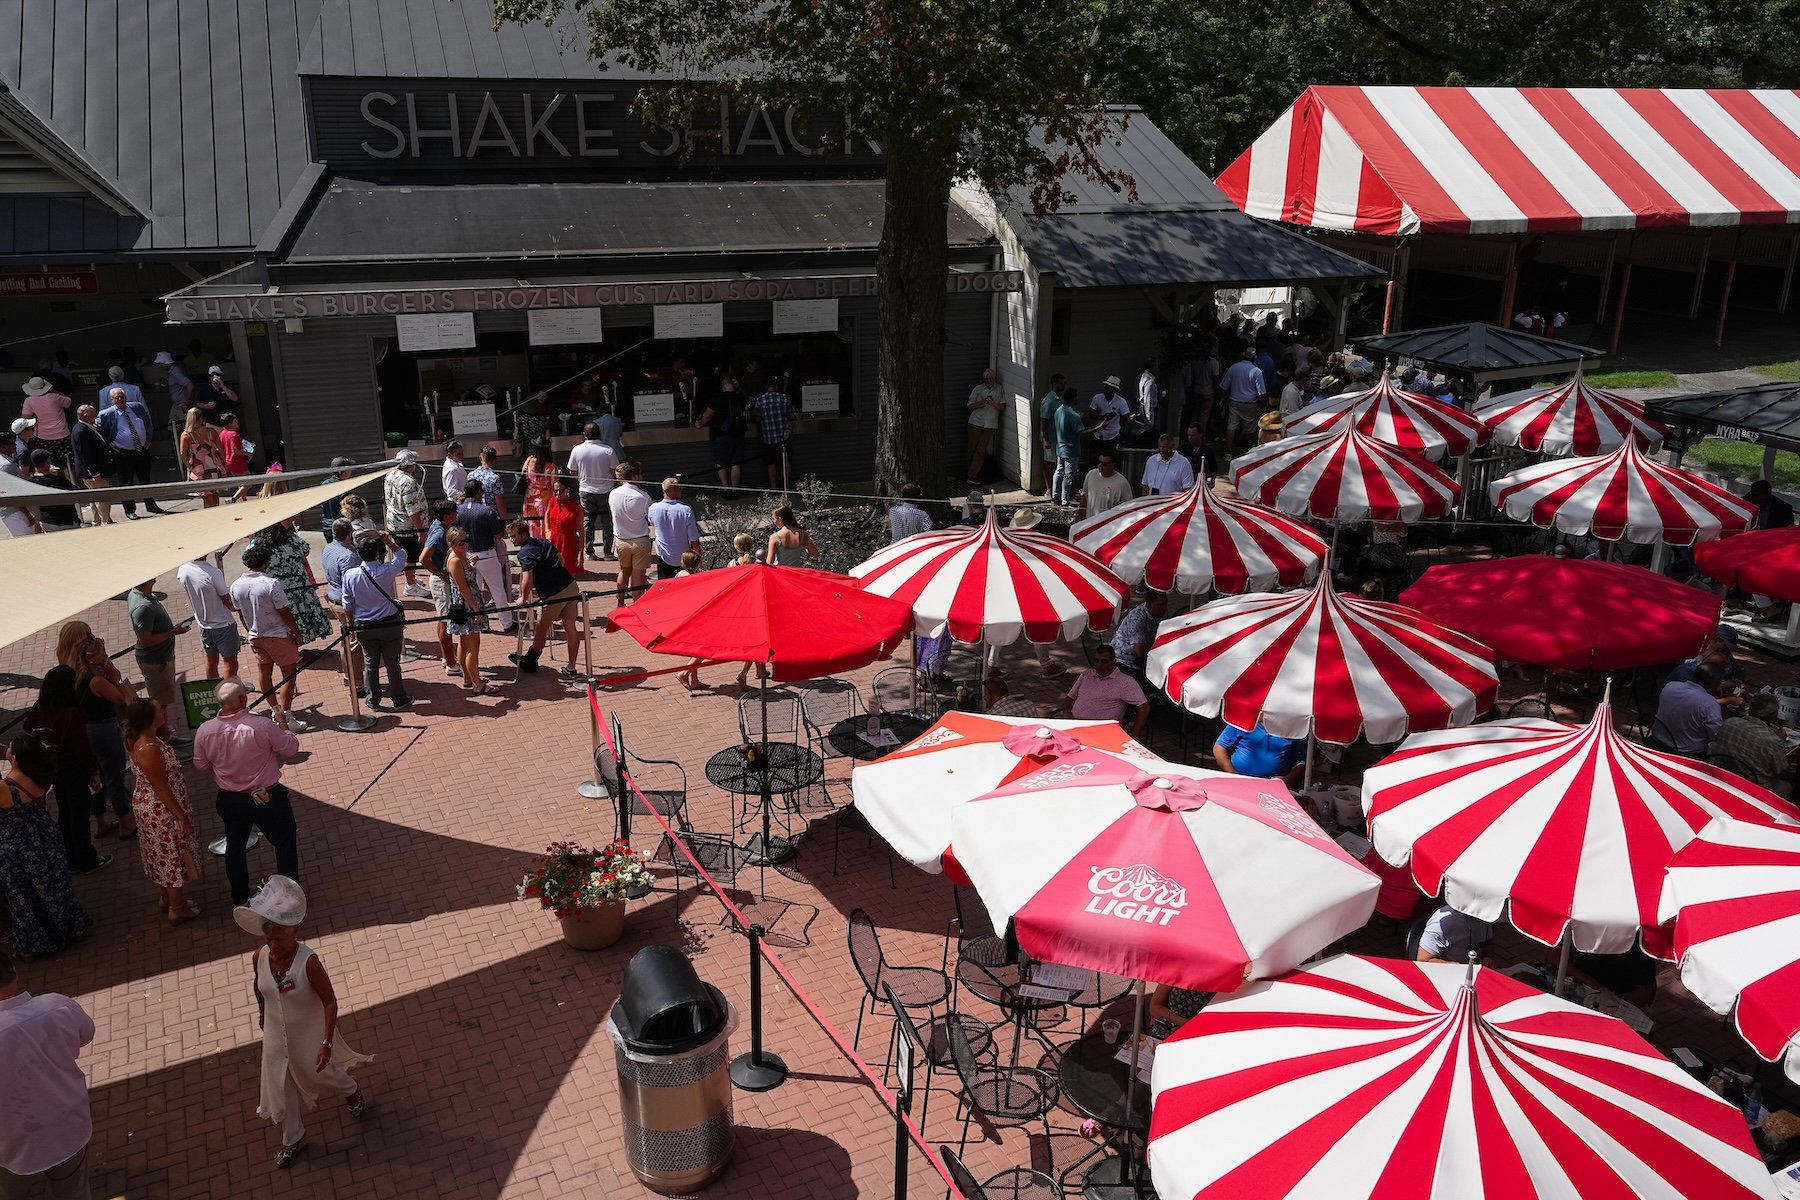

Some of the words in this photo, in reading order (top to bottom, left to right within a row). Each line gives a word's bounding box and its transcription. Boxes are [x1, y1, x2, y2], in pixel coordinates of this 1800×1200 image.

[360, 91, 619, 159] SHAKE
[0, 277, 26, 292] etting
[28, 276, 46, 289] And
[48, 276, 81, 289] Cashing
[182, 296, 308, 321] SHAKES
[322, 292, 456, 316] BURGERS
[474, 288, 579, 311] FROZEN
[595, 284, 717, 305] CUSTARD
[728, 280, 797, 301] SODA
[815, 278, 878, 297] BEER
[956, 273, 1020, 293] DOGS
[1716, 424, 1740, 441] NYRA
[1741, 429, 1759, 439] BETS
[193, 698, 218, 706] HERE
[1087, 865, 1189, 909] Coors
[1084, 895, 1181, 926] LIGHT
